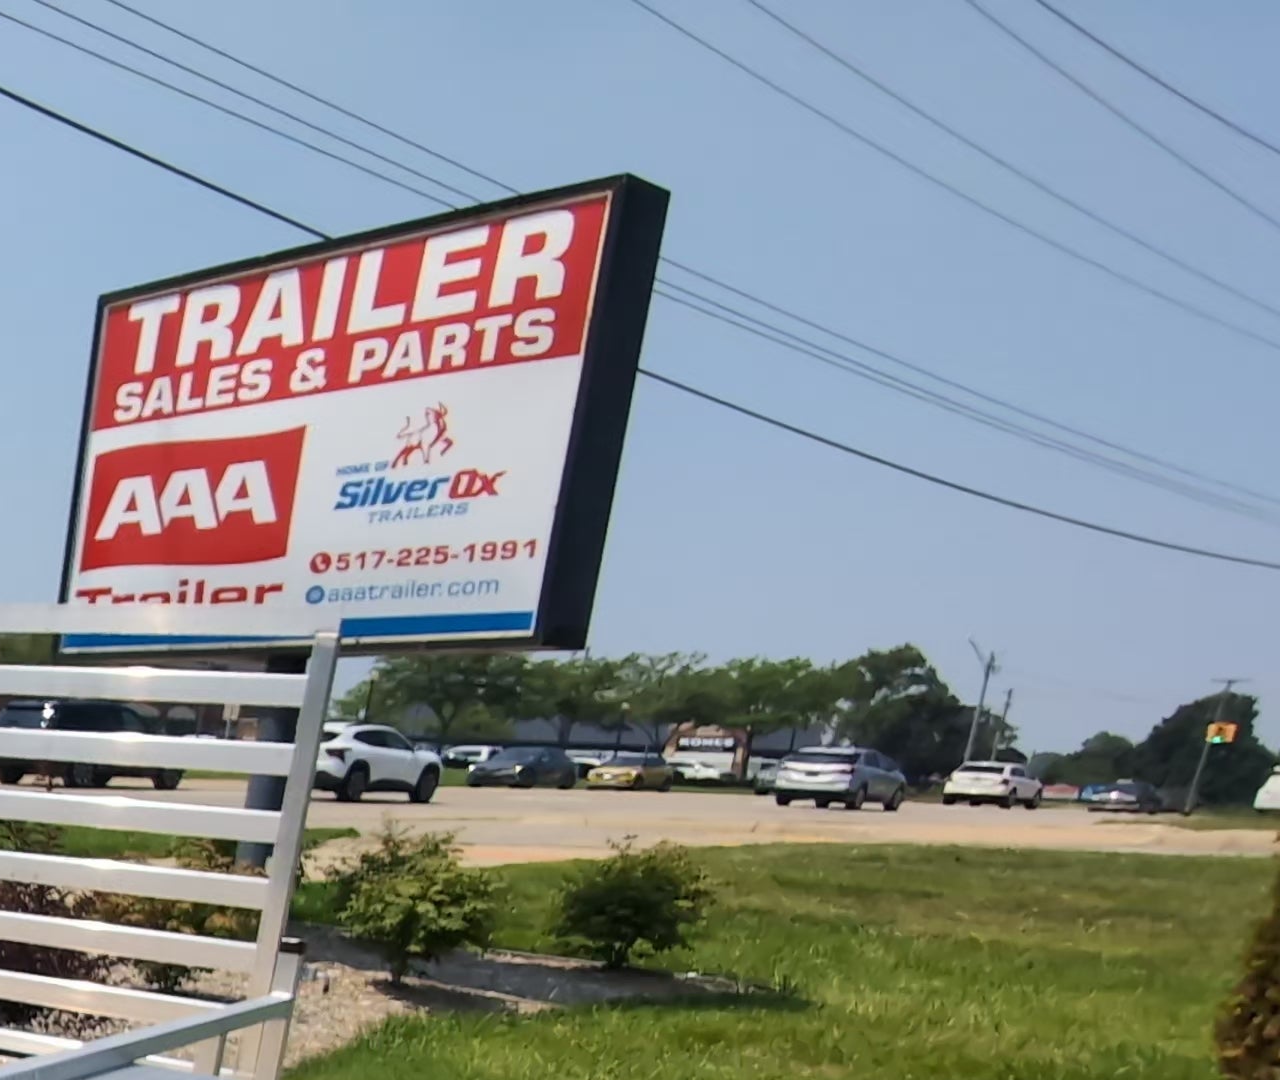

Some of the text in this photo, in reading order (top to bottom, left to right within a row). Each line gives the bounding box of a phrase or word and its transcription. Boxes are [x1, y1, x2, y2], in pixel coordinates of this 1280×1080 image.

[128, 210, 574, 375] TRAILER
[113, 308, 556, 423] SALES & PARTS
[95, 460, 278, 541] AAA
[368, 502, 470, 524] TRAILERS
[336, 538, 538, 572] 517-225-1991
[327, 579, 500, 603] aaatrailer.com
